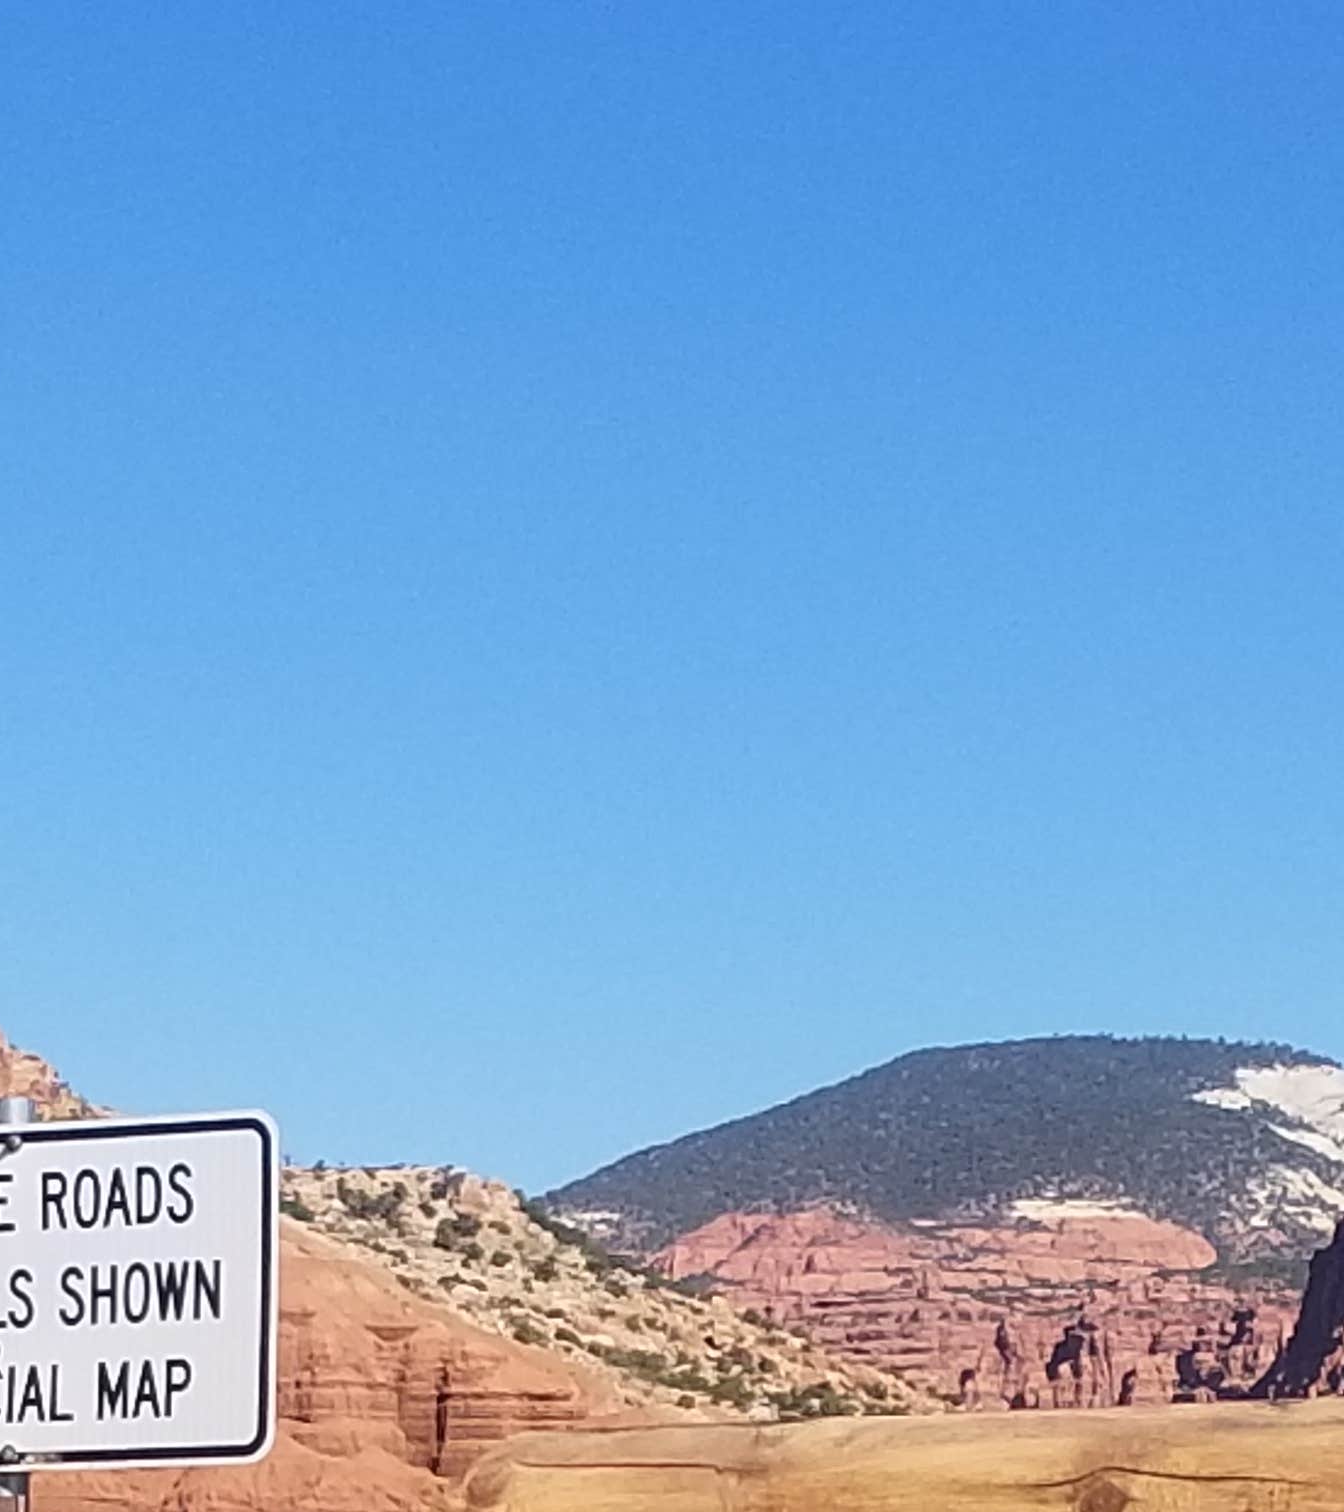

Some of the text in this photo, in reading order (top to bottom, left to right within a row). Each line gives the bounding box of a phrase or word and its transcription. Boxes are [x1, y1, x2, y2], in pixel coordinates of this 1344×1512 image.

[41, 1163, 194, 1231] ROADS
[59, 1259, 222, 1327] SHOWN
[97, 1358, 192, 1421] MAP
